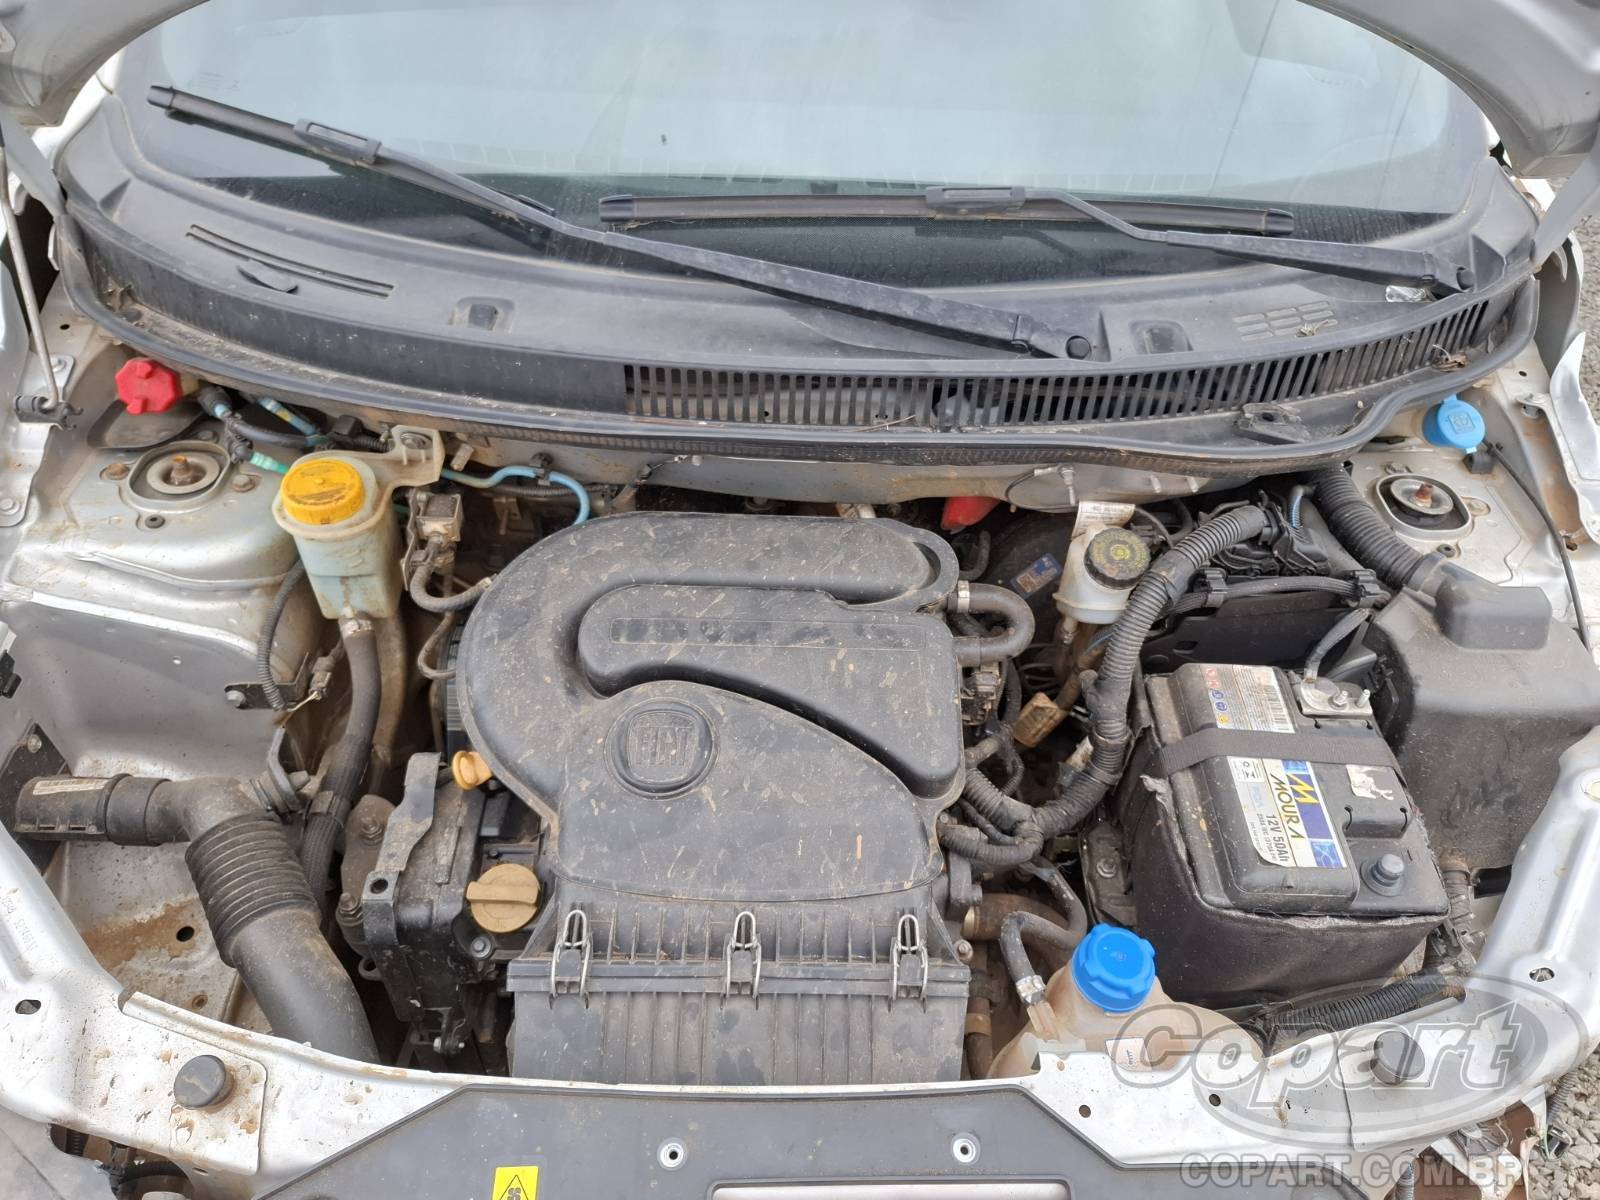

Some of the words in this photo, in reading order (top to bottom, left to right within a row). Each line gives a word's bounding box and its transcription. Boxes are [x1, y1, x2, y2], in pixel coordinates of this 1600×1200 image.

[629, 726, 699, 766] FIAT
[1271, 773, 1305, 839] MOURA
[1266, 814, 1281, 833] 12V
[1273, 836, 1290, 861] 50Ah
